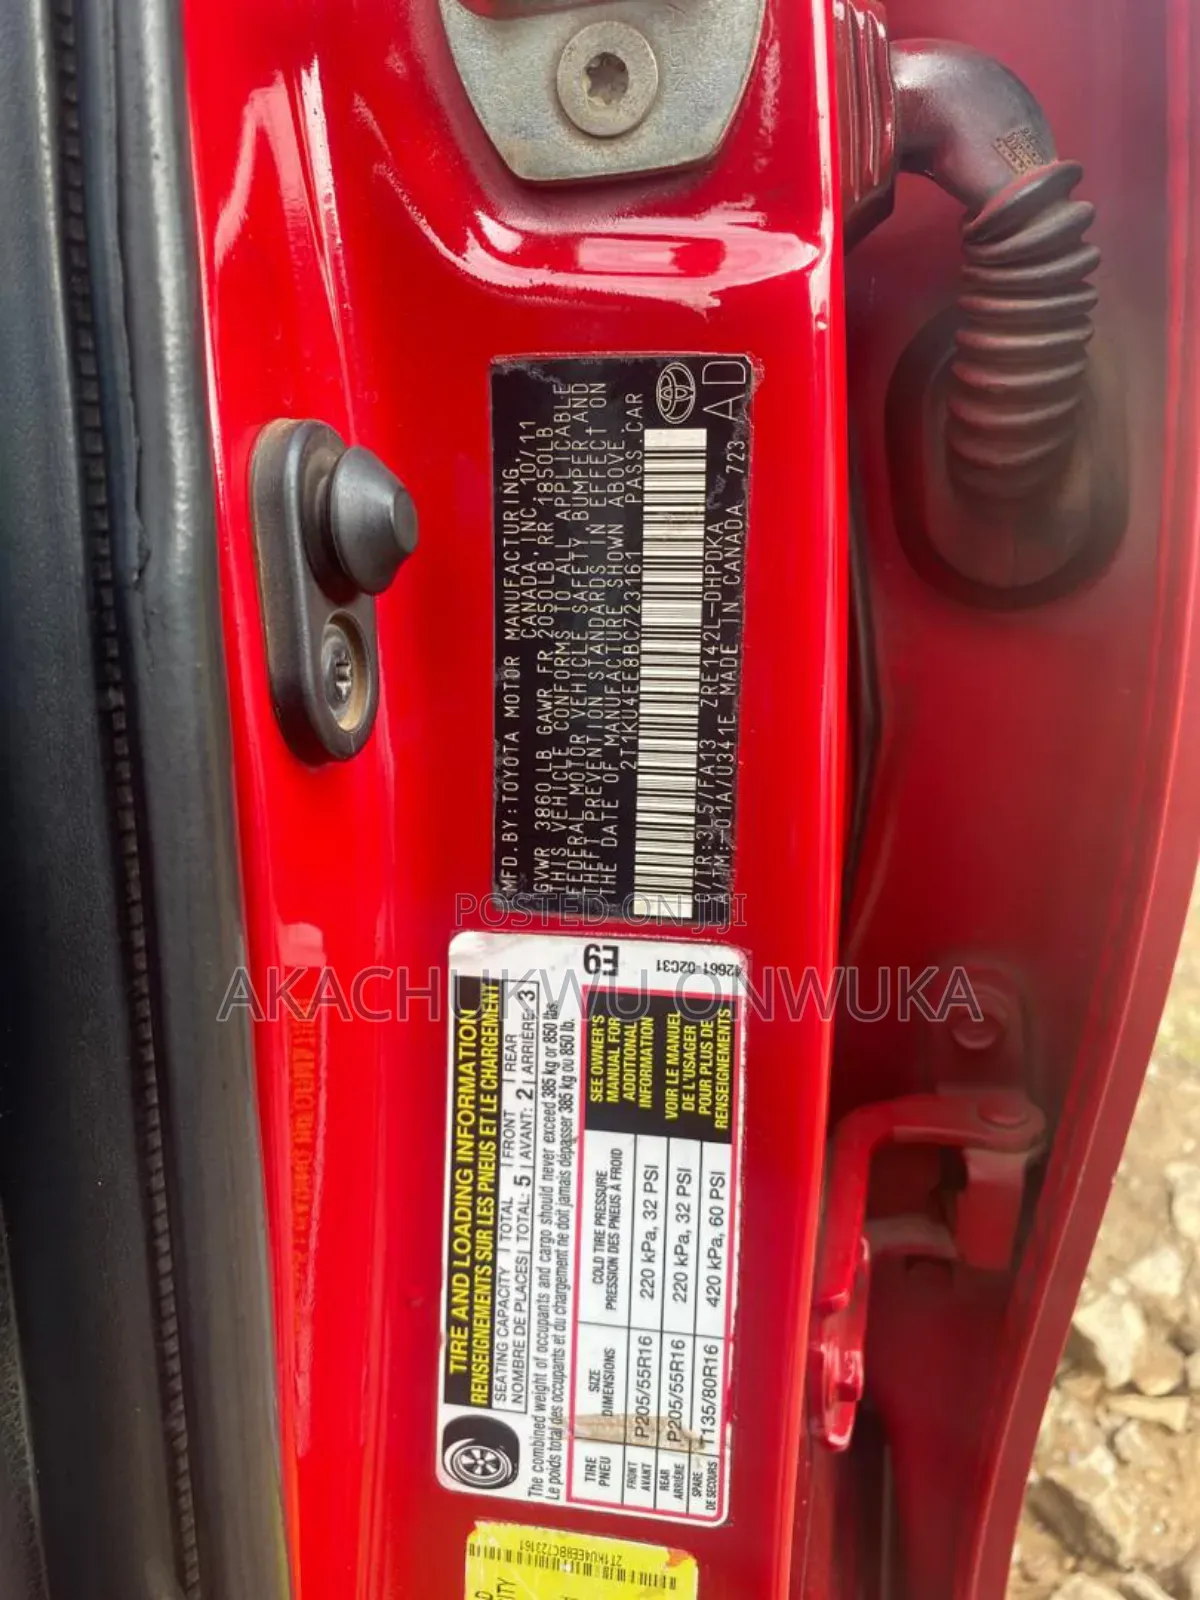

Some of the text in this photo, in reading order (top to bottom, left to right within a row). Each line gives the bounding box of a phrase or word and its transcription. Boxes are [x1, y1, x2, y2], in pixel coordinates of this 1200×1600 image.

[520, 421, 536, 485] 10/11
[727, 440, 743, 473] 723
[538, 522, 554, 545] RR
[724, 504, 742, 585] CANADA
[550, 385, 572, 893] THIS VEHICLE CONFORMS TO ALL APPLICABLE
[584, 383, 606, 895] THEFT PREVENTION STANDARDS IN EFFECT ON
[722, 602, 739, 623] IN
[504, 655, 520, 718] MOTOR
[537, 649, 553, 673] FR
[571, 632, 587, 720] VEHICLE
[600, 429, 624, 895] THE DATE OF MANUFACTURE SHOWN ABOVE.
[719, 646, 736, 695] MADE
[536, 688, 552, 735] GAWR
[536, 750, 552, 772] LB
[569, 734, 586, 795] MOTOR
[535, 782, 551, 830] 3860
[534, 847, 550, 893] GVWR
[567, 811, 585, 895] FEDERAL
[583, 943, 619, 976] E9
[518, 989, 536, 1002] 3
[504, 1033, 518, 1072] REAR
[542, 1022, 558, 1044] 850
[545, 1045, 557, 1058] or
[590, 1014, 606, 1102] SEE OWNER'S
[606, 1016, 622, 1102] MANUAL FOR
[623, 1022, 639, 1101] ADDITIONAL
[639, 1015, 654, 1108] INFORMATION
[665, 1009, 681, 1119] VOIR LE MANUEL
[541, 1060, 559, 1075] kg
[541, 1078, 557, 1099] 385
[681, 1024, 697, 1111] DE L'USAGER
[698, 1019, 714, 1115] POUR PLUS DE
[716, 1007, 731, 1129] RENSEIGNEMENTS
[502, 1109, 517, 1159] FRONT
[516, 1088, 534, 1160] AVANT: 2
[540, 1101, 556, 1144] exceed
[448, 1008, 477, 1374] TIRE AND LOADING INFORMATION
[472, 983, 499, 1404] RENSEIGNEMENTS SUR LES PNEUS ET LE CHARGEMENT
[541, 1147, 555, 1182] never
[498, 1196, 514, 1241] TOTAL
[513, 1175, 532, 1242] TOTAL: 5
[537, 1185, 553, 1225] should
[592, 1170, 608, 1285] COLD TIRE PRESSURE
[604, 1147, 623, 1310] PRESSION DES PNEUS À FROID
[639, 1164, 660, 1300] 220 kPa, 32 PSI
[671, 1167, 693, 1303] 220 kPa, 32 PSI
[539, 1229, 555, 1263] cargo
[546, 1018, 576, 1501] Le poids total des occupants et du chargement ne doit jamais dépasser 385 kg ou 850 lb.
[706, 1171, 726, 1308] 420 kPa, 60 PSI
[535, 1266, 551, 1289] and
[494, 1266, 510, 1402] SEATING CAPACITY
[511, 1255, 529, 1404] NOMBRE DE PLACES
[533, 1292, 552, 1353] occupants
[531, 1372, 550, 1412] weight
[532, 1356, 548, 1369] of
[601, 1348, 616, 1418] DIMENSIONS
[635, 1335, 653, 1438] P205/55R16
[667, 1339, 686, 1443] P205/55R16
[700, 1344, 719, 1449] T135/80R16
[529, 1414, 546, 1473] combined
[584, 1457, 598, 1482] TIRE
[528, 1476, 544, 1497] The
